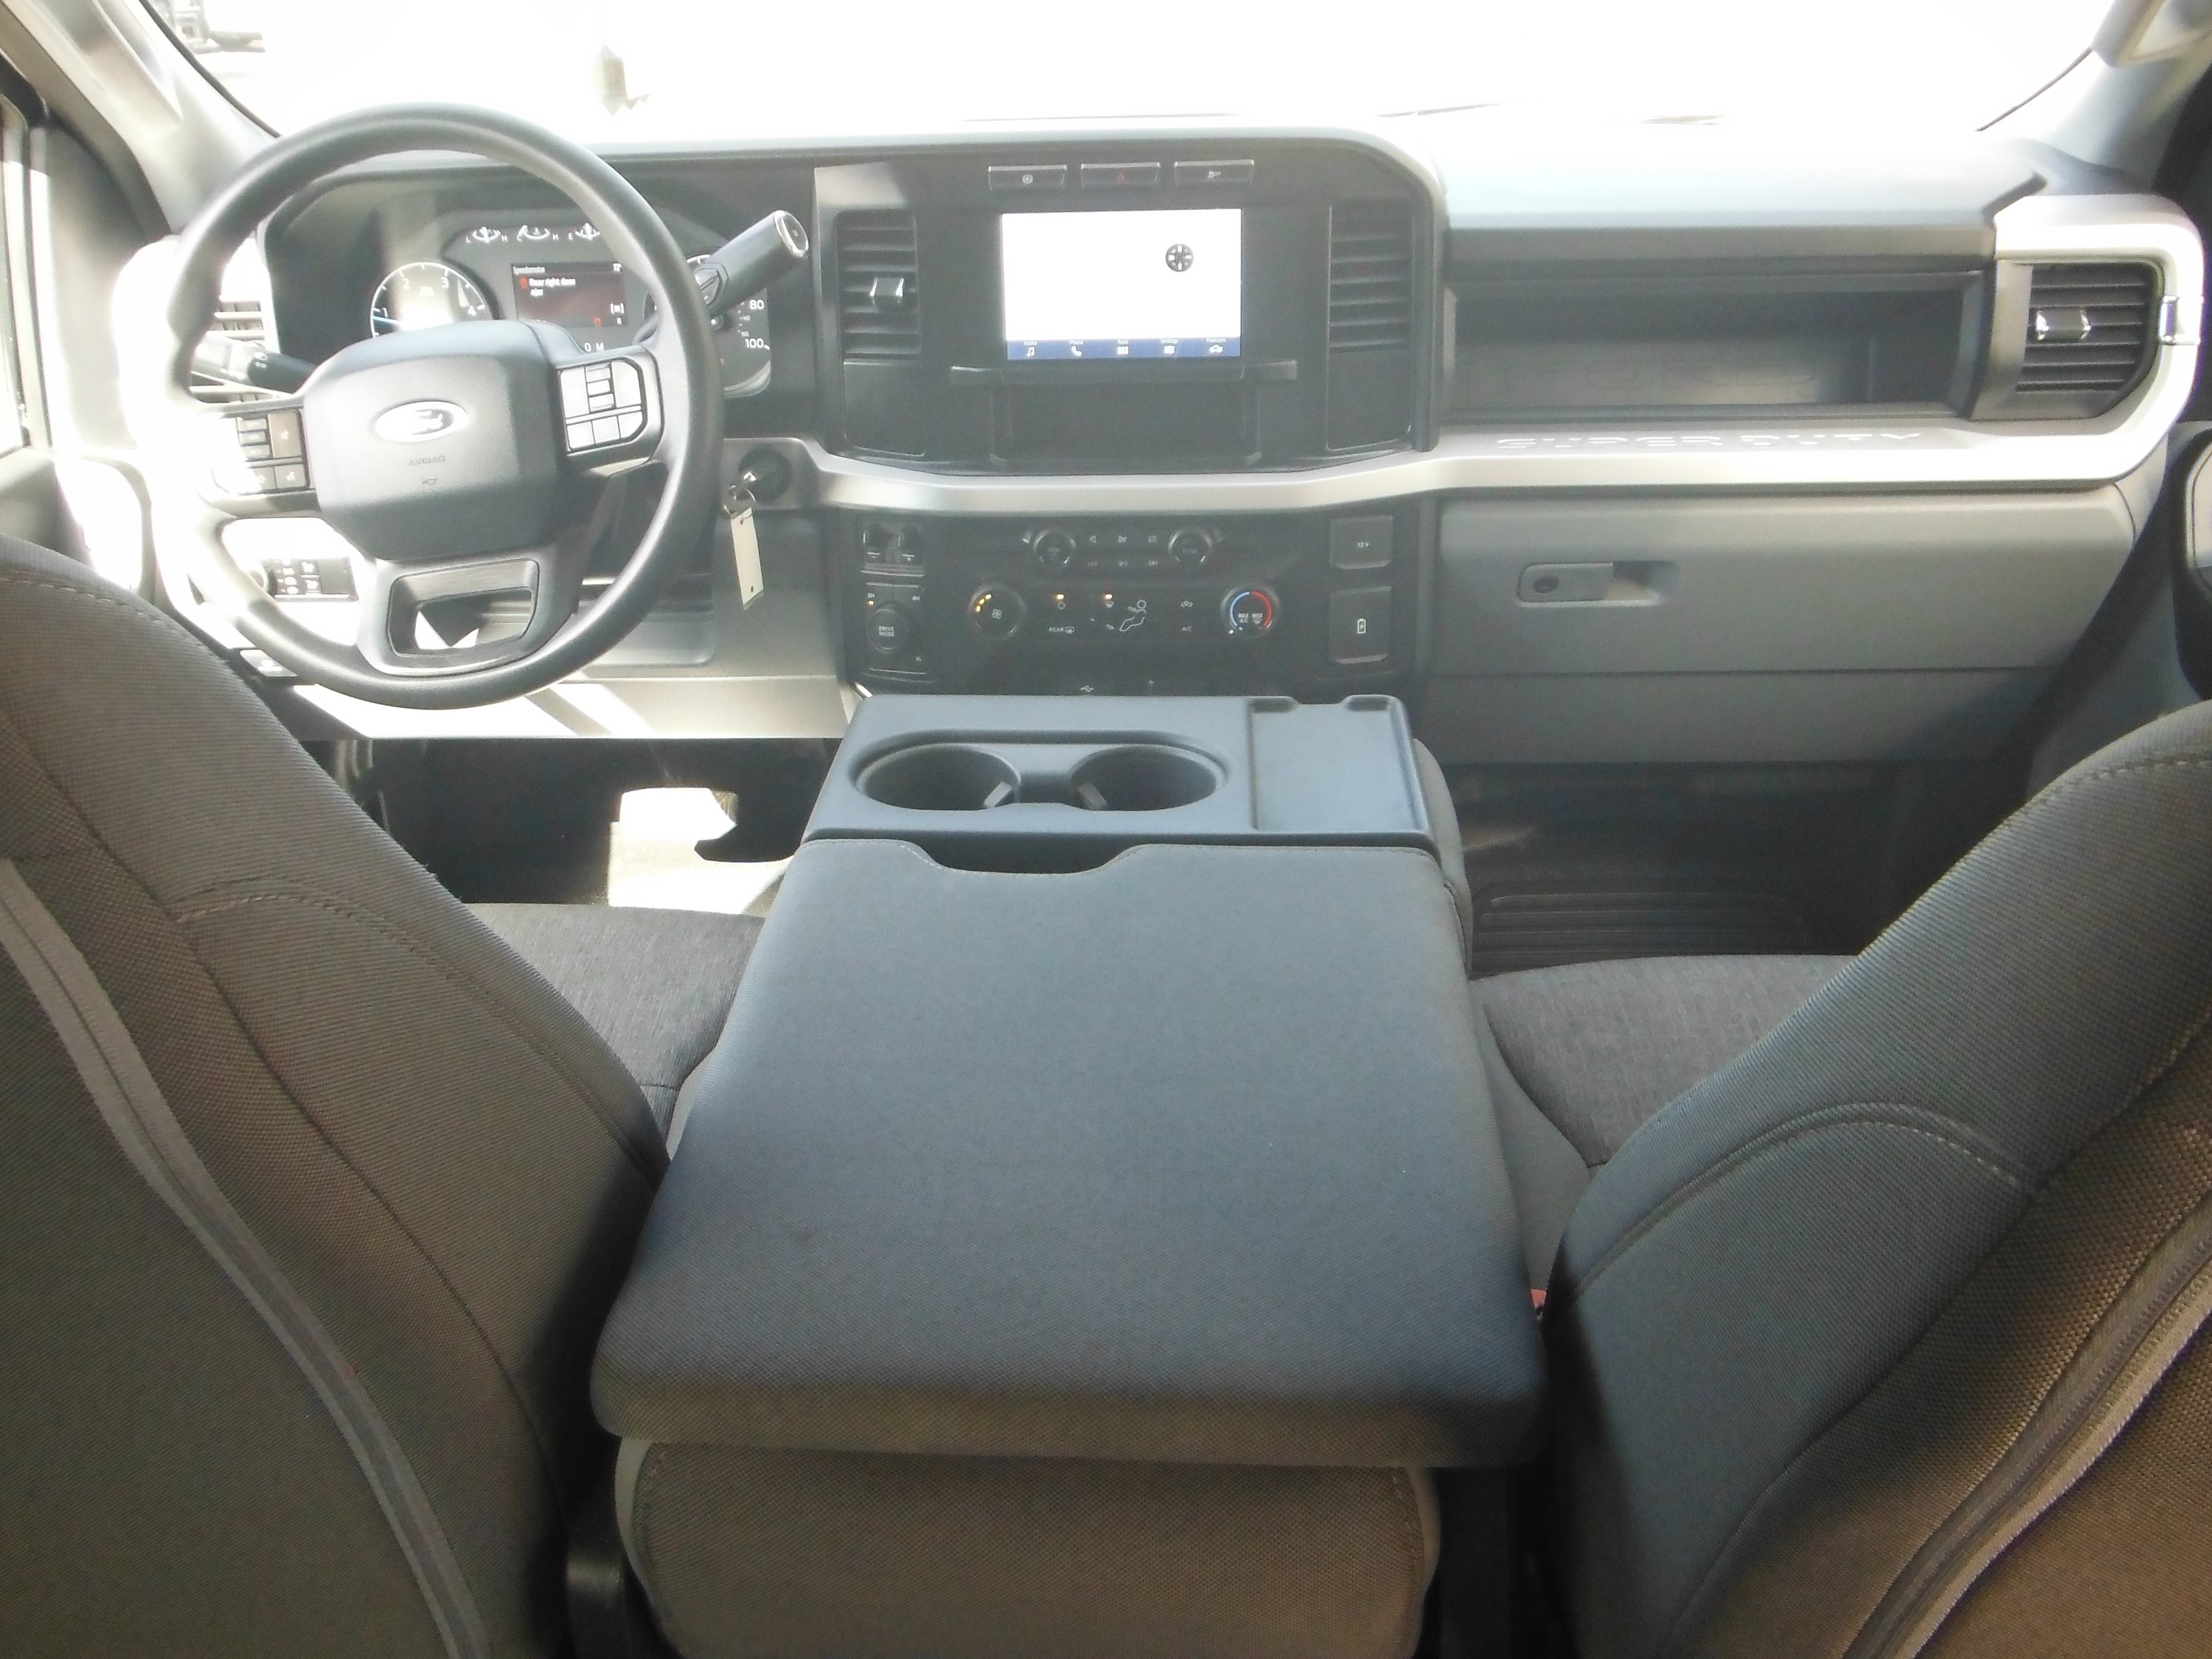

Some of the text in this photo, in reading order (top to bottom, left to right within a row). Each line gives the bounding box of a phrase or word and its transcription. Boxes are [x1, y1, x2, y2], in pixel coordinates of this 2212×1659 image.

[402, 278, 410, 290] 2
[441, 276, 449, 289] 3
[529, 277, 576, 287] Rear right door
[750, 299, 765, 310] 80
[383, 307, 389, 318] 1
[467, 305, 477, 316] 4
[584, 342, 604, 352] D M
[745, 338, 764, 349] 100
